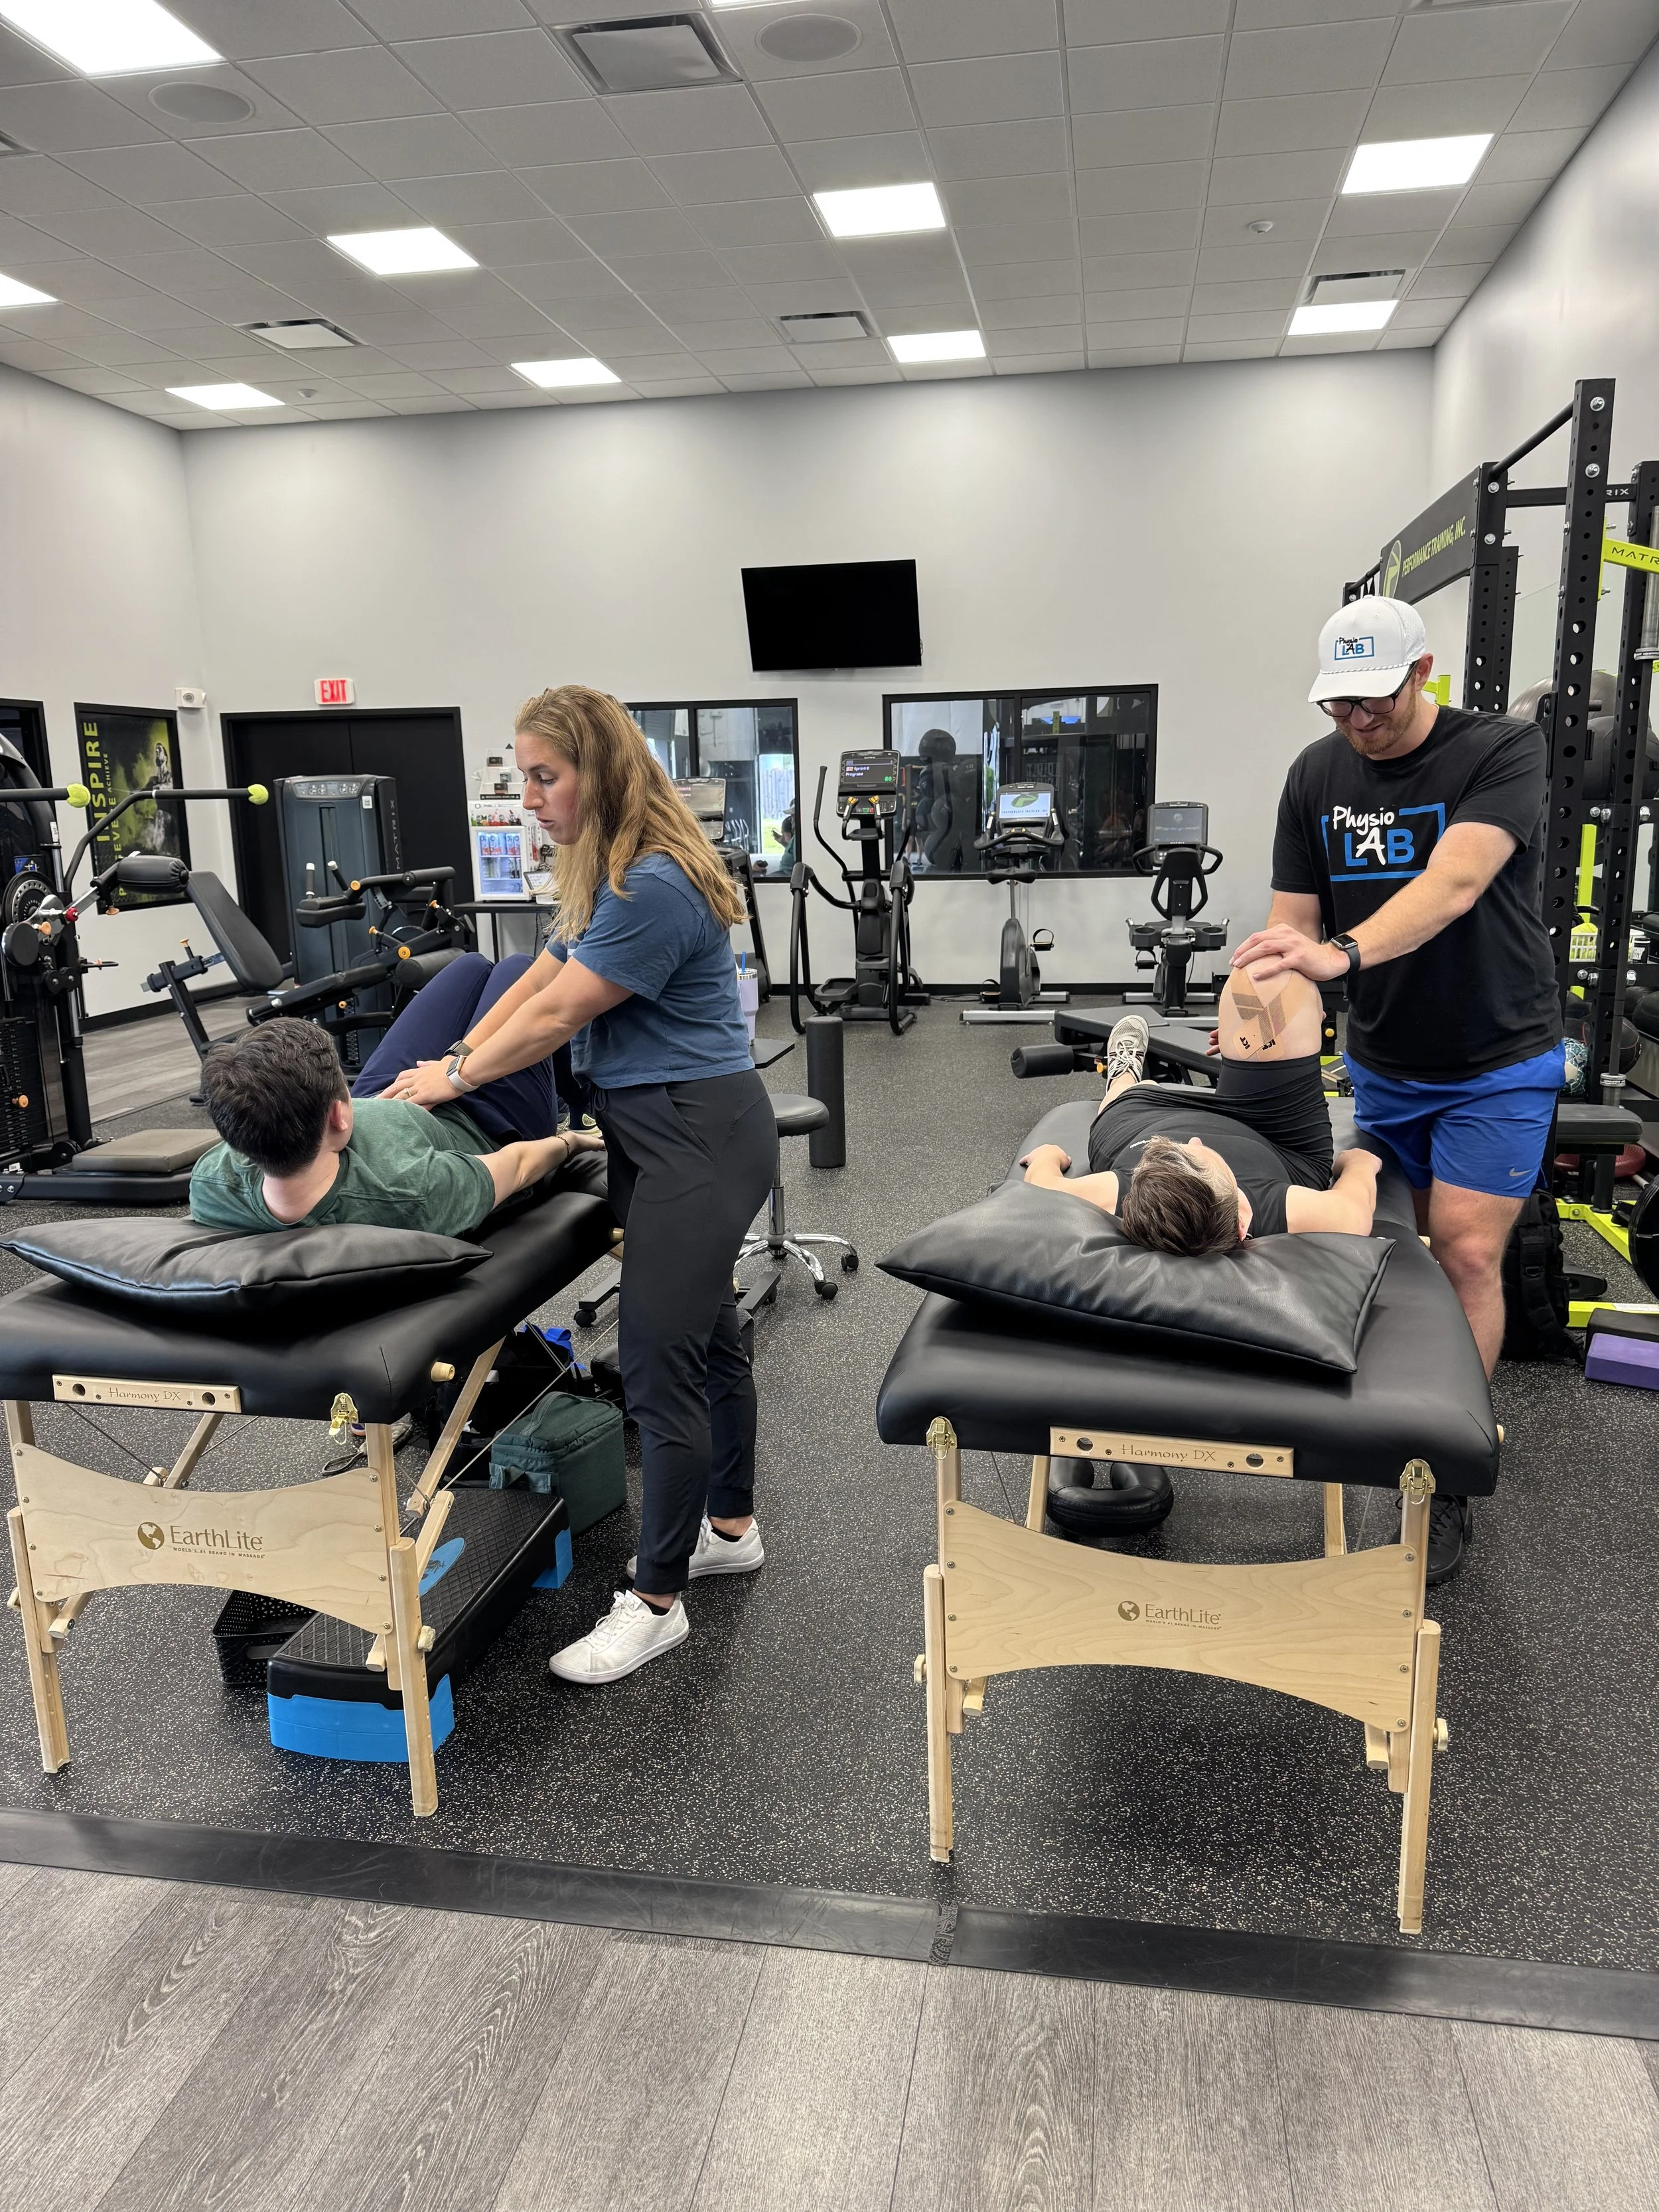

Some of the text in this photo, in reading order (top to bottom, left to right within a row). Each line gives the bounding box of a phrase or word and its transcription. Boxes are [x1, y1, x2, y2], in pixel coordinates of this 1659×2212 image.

[1402, 516, 1466, 577] PERFORMANCE TRAINING, INC.
[1338, 637, 1358, 646] Physio
[1342, 644, 1364, 655] LAB
[320, 680, 346, 703] EXIT
[104, 753, 112, 792] ACHIEVE
[1333, 805, 1395, 836] Physio
[390, 800, 400, 869] MATRIX
[1344, 827, 1415, 867] LAB
[108, 1388, 180, 1402] Harmony DX
[1120, 1444, 1216, 1462] Harmony DX
[170, 1525, 263, 1551] EarthLite
[1145, 1603, 1220, 1625] EarthLite
